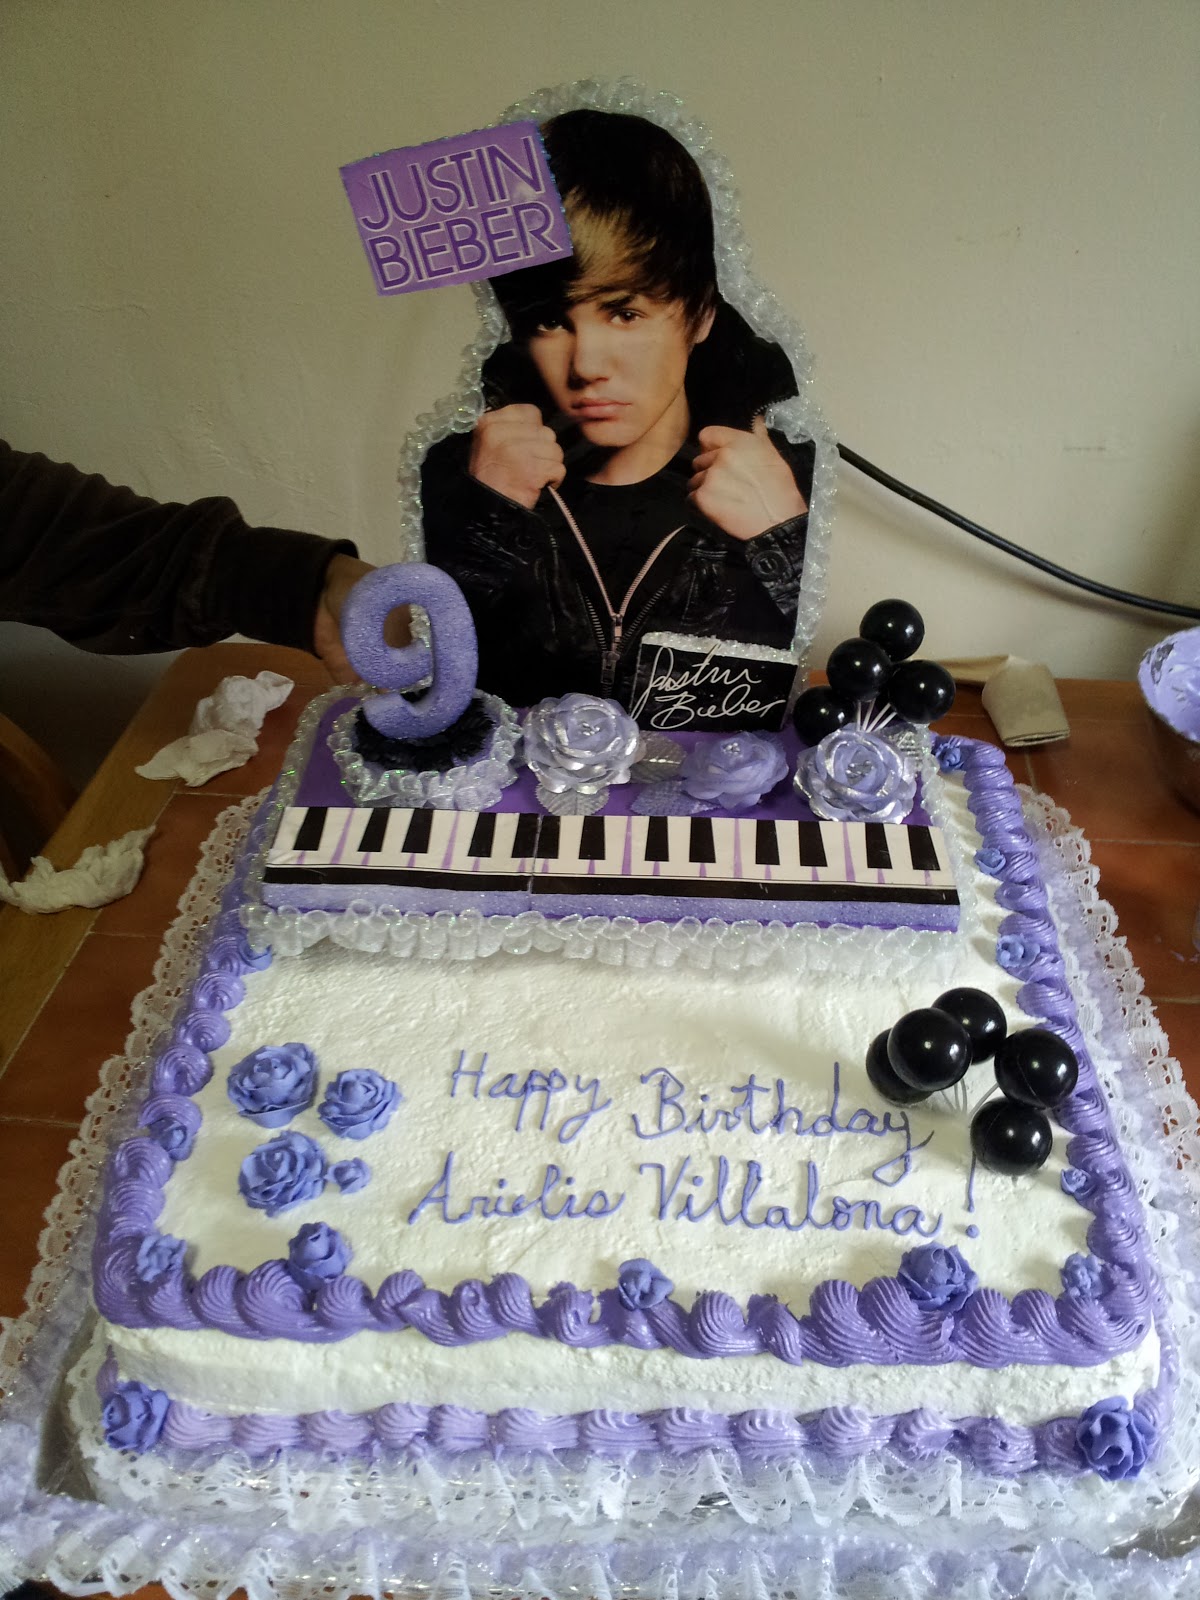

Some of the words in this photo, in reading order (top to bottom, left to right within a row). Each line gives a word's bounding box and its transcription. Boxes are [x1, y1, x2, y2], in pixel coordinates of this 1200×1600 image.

[360, 135, 546, 232] JUSTIN
[367, 200, 564, 291] BIEBER
[340, 561, 479, 739] 9
[450, 1049, 613, 1144] Happy
[631, 1061, 935, 1187] Birthday
